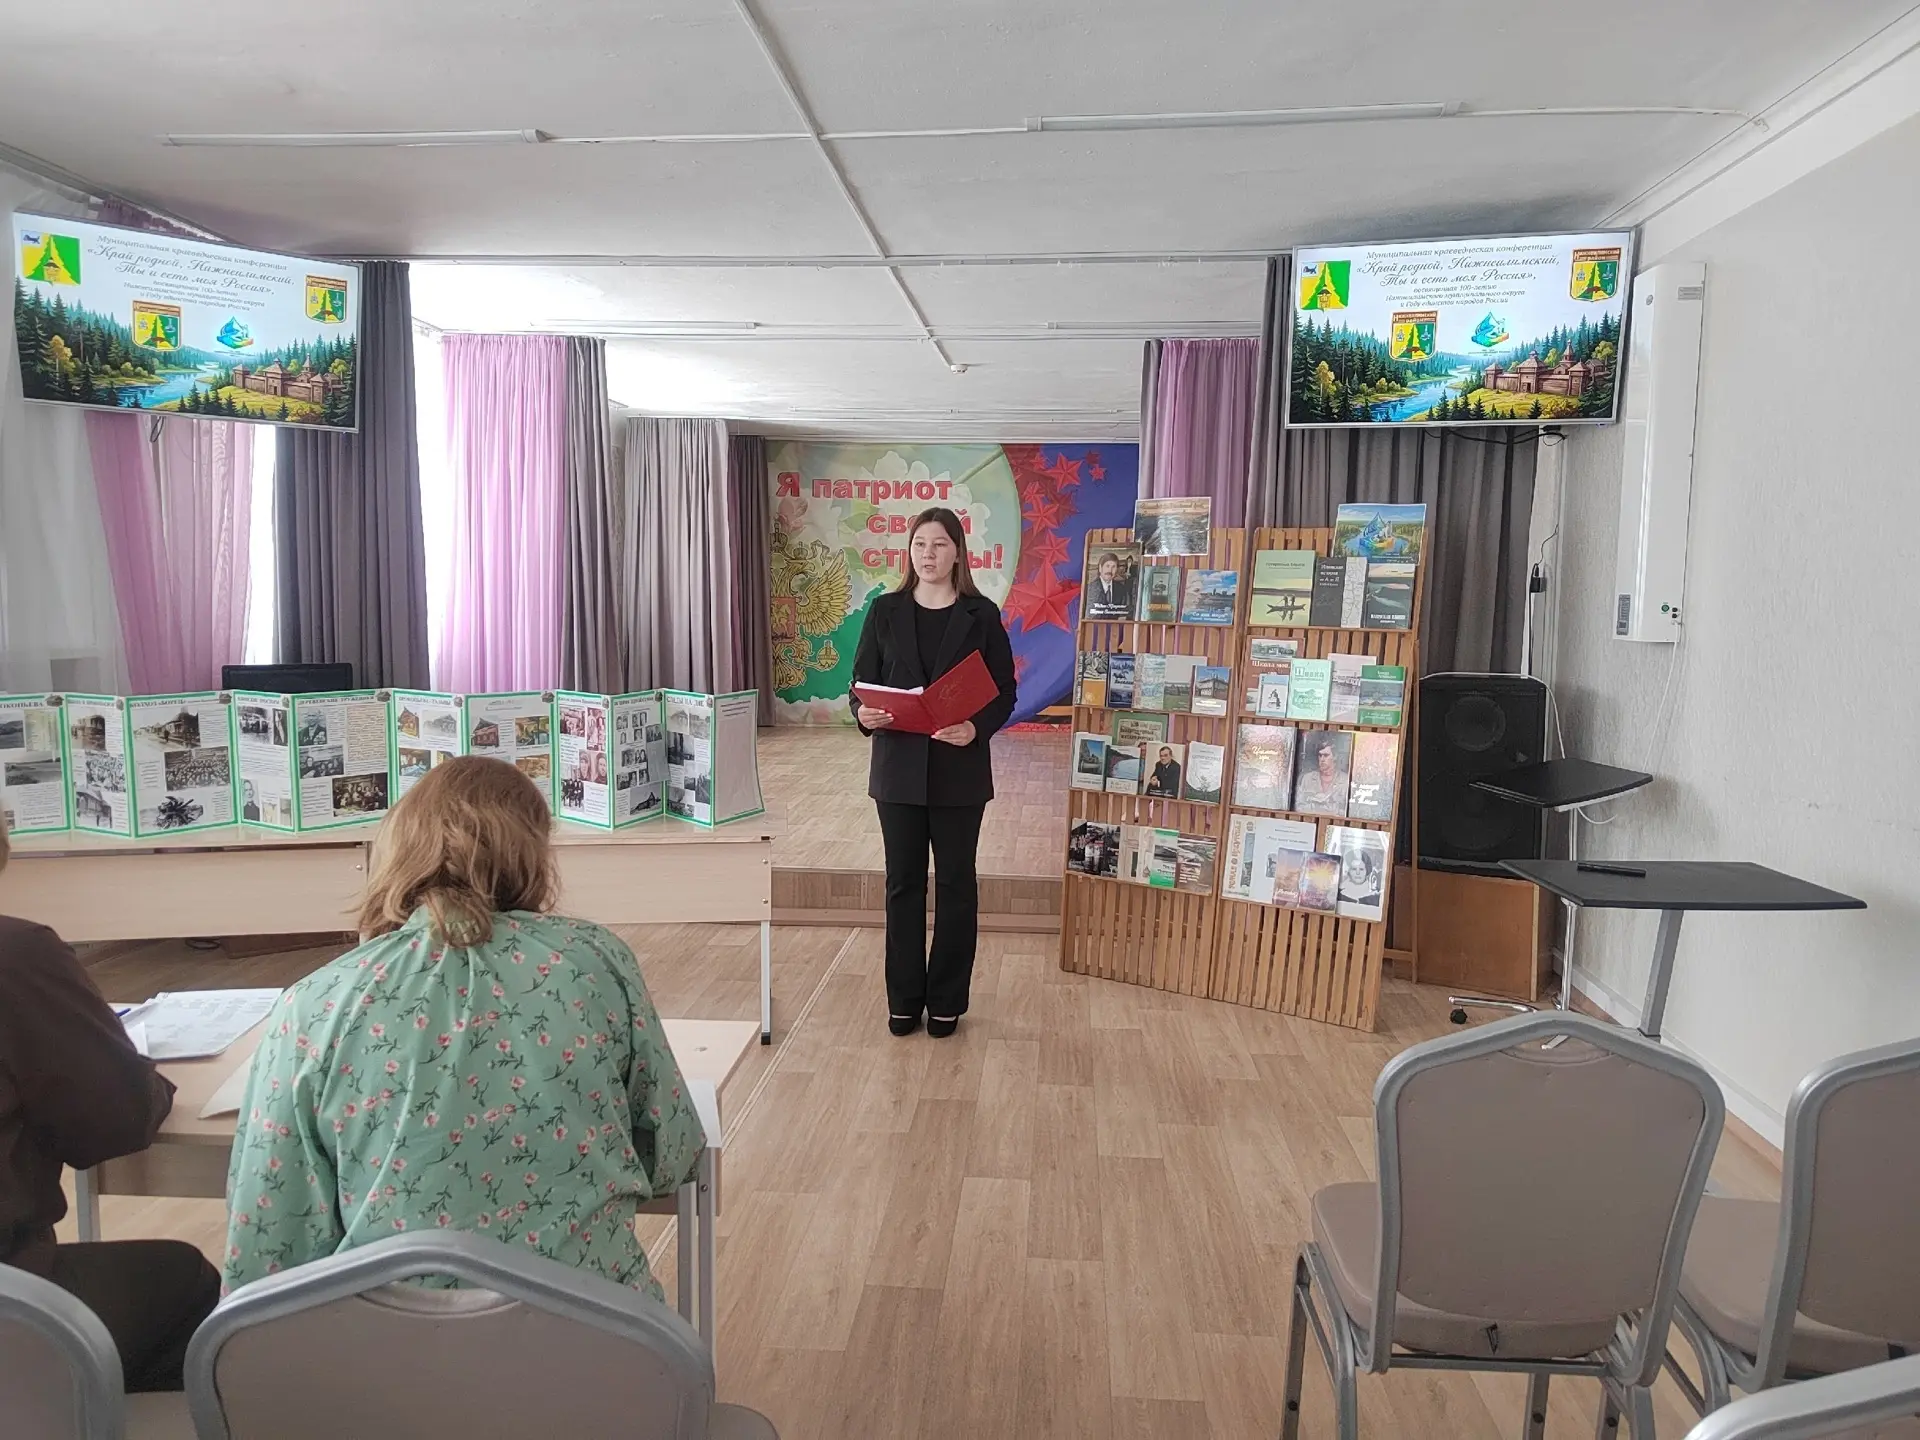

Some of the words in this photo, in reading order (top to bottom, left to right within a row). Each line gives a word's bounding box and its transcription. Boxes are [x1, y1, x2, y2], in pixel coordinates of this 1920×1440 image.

[87, 244, 134, 265] «Край
[135, 253, 184, 271] родной,
[187, 259, 295, 285] Нижнеилимский,
[97, 235, 170, 253] Муниципальная
[233, 257, 287, 271] конференция
[1357, 260, 1398, 275] «Край
[1399, 258, 1444, 275] родной,
[1448, 254, 1560, 270] Нижнеилимский,
[1366, 247, 1433, 259] Муниципальная
[1434, 245, 1494, 257] краеведческая
[1495, 243, 1553, 253] конференция
[114, 261, 145, 276] Ты
[161, 271, 189, 282] есть
[220, 277, 275, 295] Россия»,
[1380, 274, 1406, 287] Ты
[1421, 275, 1448, 285] есть
[1451, 274, 1476, 282] моя
[1480, 269, 1537, 282] Россия»,
[776, 472, 800, 497] Я
[811, 479, 953, 505] патриот
